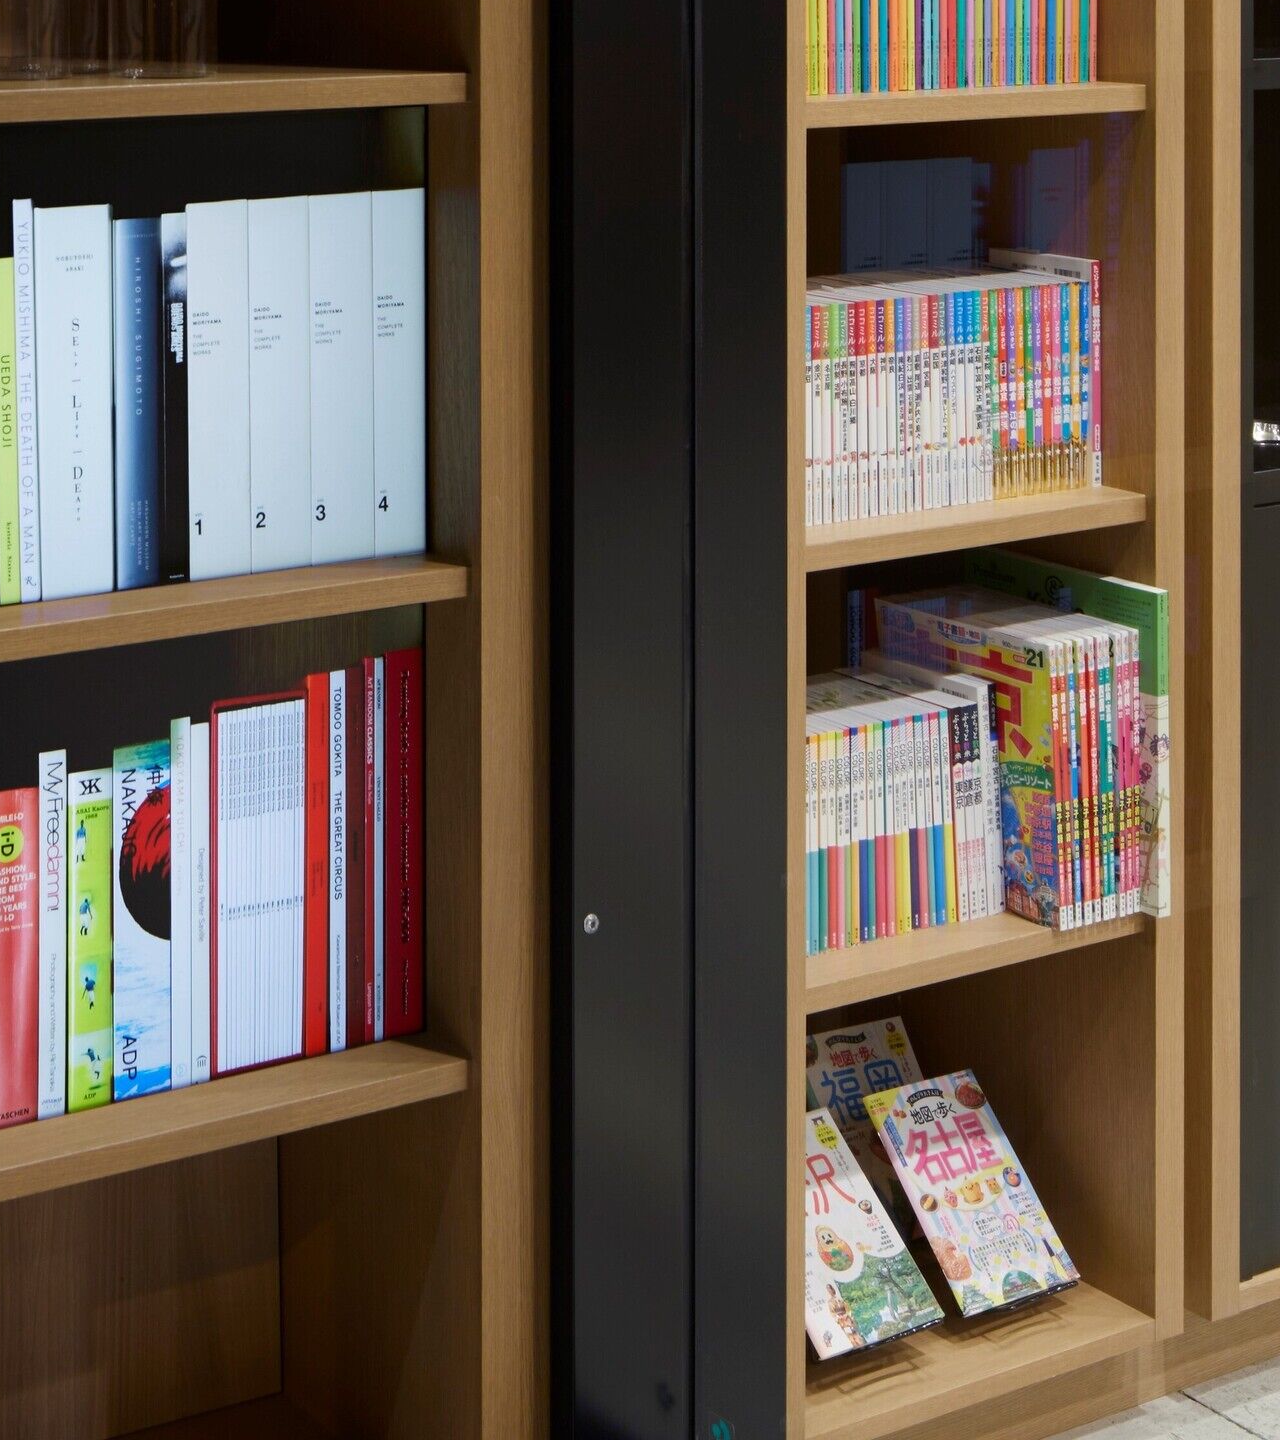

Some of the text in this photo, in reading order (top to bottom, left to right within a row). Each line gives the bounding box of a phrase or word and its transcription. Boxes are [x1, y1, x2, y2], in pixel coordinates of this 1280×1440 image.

[813, 312, 821, 348] ココミル
[877, 307, 885, 342] ココミル
[0, 355, 14, 448] UEDA SHOJI
[17, 221, 36, 564] YUKIO MISHIMA THE DEATH OF A MAN
[255, 512, 266, 529] 2
[315, 505, 326, 521] 3
[378, 496, 389, 512] 4
[333, 687, 343, 777] TOMOO GOKITA
[43, 761, 63, 912] My Freedamn!
[333, 791, 343, 900] THE GREAT CIRCUS
[196, 848, 207, 942] Designed by Peter Saville
[122, 1035, 137, 1081] ADP
[910, 1102, 956, 1125] 地図で歩く
[904, 1112, 1003, 1185] 名古屋
